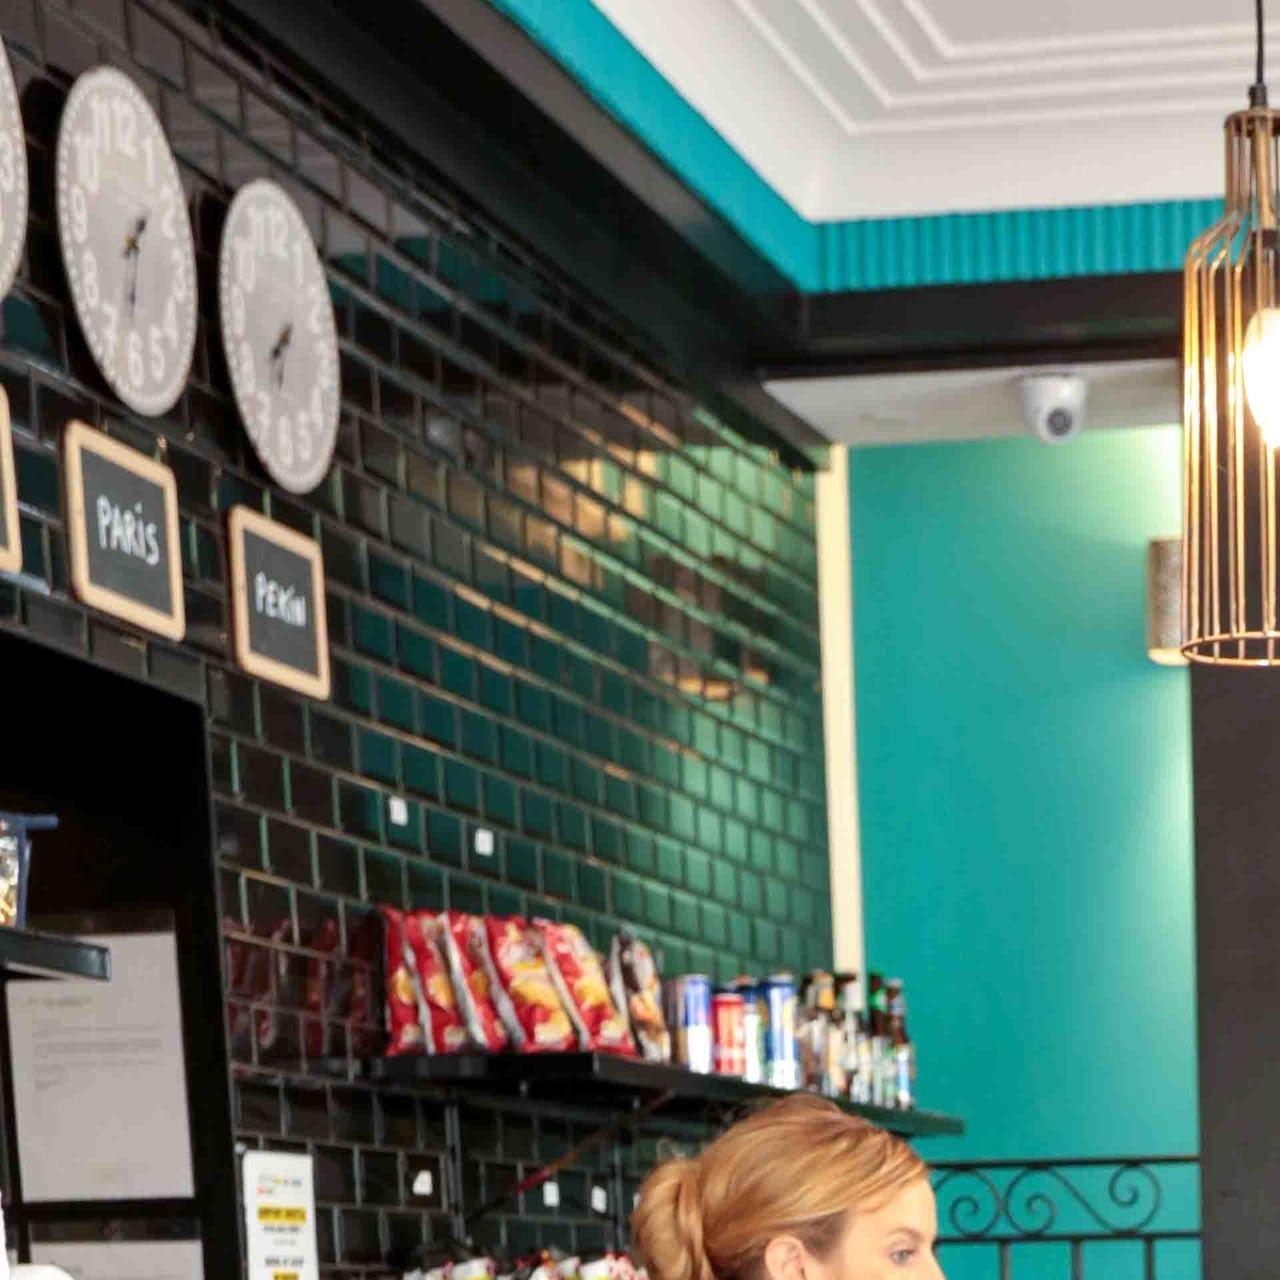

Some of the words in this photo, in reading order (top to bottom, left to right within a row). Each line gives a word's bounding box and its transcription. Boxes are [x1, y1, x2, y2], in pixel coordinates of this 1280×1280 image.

[112, 95, 139, 158] 12
[145, 134, 155, 188] 1
[71, 185, 88, 243] 9
[160, 182, 176, 240] 2
[81, 245, 99, 307] 8
[170, 244, 188, 303] 3
[128, 330, 143, 389] 6
[149, 324, 165, 383] 5
